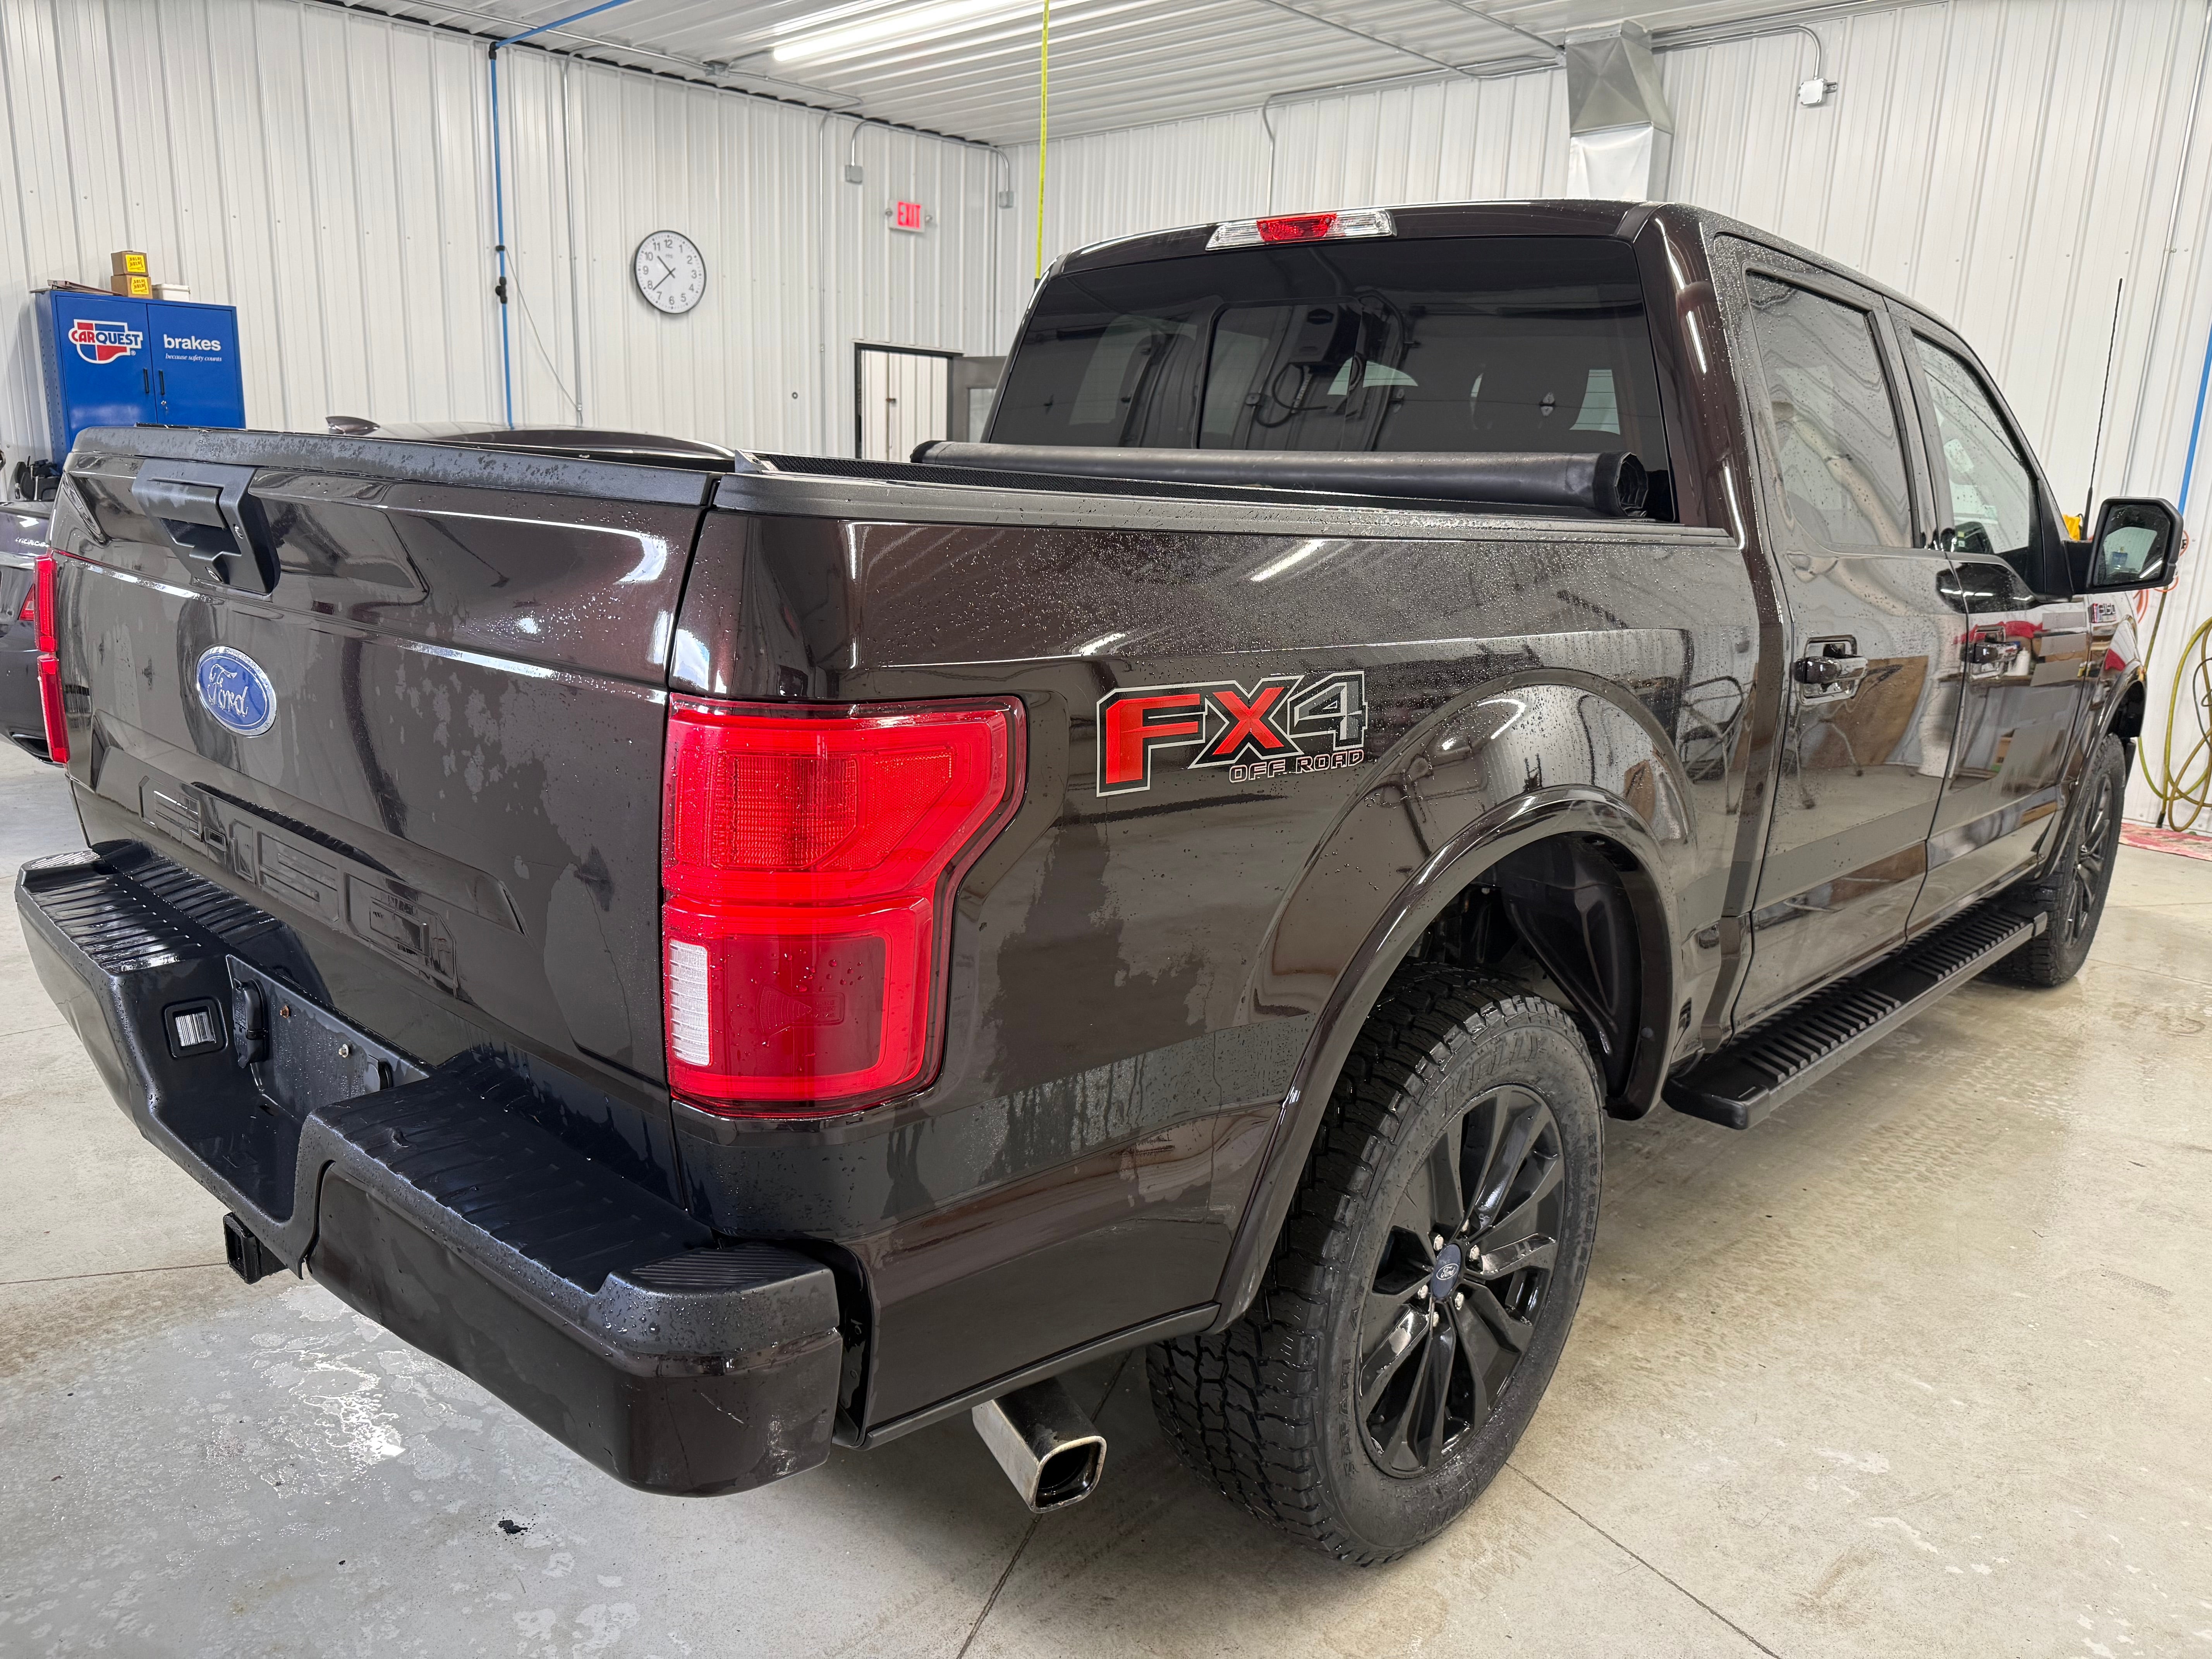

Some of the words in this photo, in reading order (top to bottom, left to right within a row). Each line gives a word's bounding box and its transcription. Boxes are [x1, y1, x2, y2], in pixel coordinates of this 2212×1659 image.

[898, 201, 921, 229] EXIT
[653, 242, 660, 251] 11
[664, 239, 673, 249] 12
[679, 244, 683, 253] 1
[645, 251, 653, 261] 10
[687, 256, 692, 264] 2
[642, 266, 649, 275] 9
[691, 270, 697, 279] 3
[647, 280, 653, 289] 8
[689, 284, 694, 292] 4
[656, 291, 662, 300] 7
[680, 293, 686, 302] 5
[669, 296, 675, 305] 6
[71, 330, 140, 346] CARQUEST
[163, 334, 221, 351] brakes
[207, 663, 249, 717] Ford
[1096, 670, 1368, 797] FX4
[1229, 761, 1285, 783] OFF
[1295, 749, 1364, 775] ROAD
[1440, 1266, 1455, 1278] Ford
